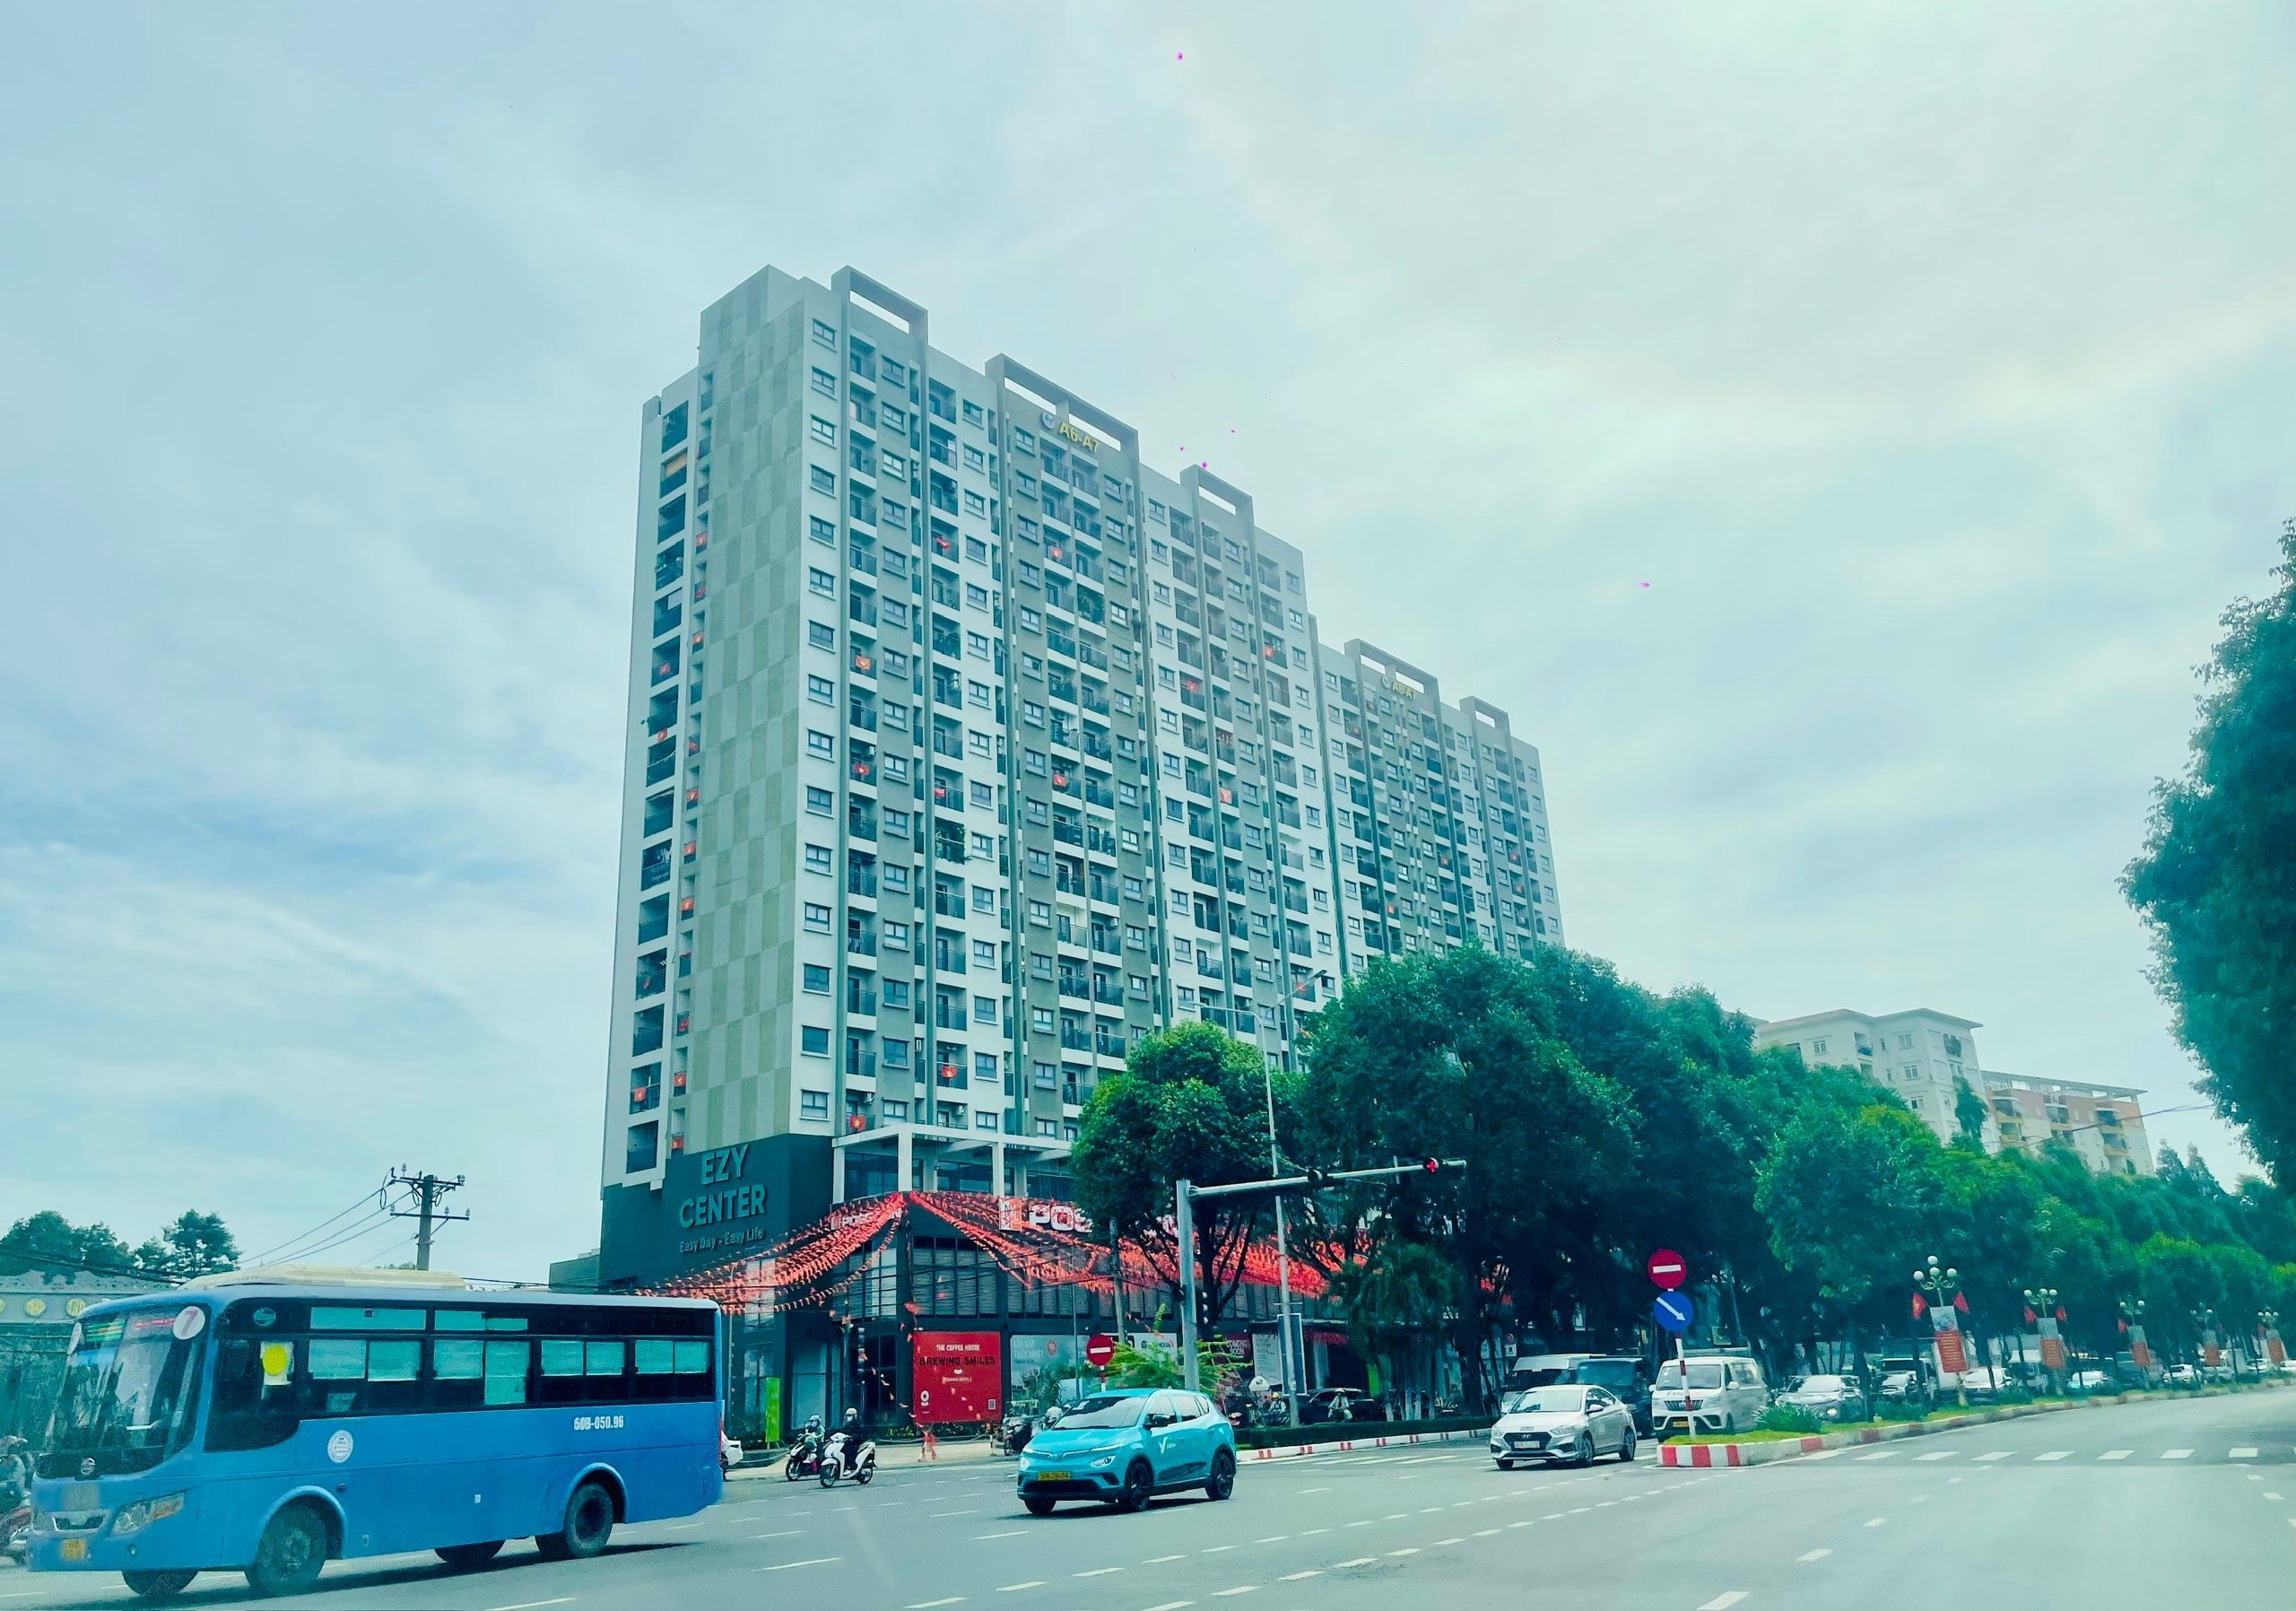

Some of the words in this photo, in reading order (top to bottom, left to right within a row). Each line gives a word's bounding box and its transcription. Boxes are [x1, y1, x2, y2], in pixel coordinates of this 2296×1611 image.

[1059, 421, 1100, 453] A6-A7
[701, 1144, 749, 1184] EZY
[679, 1184, 766, 1229] CENTER
[680, 1241, 699, 1253] Easy
[724, 1232, 744, 1245] Easy
[746, 1226, 764, 1241] Life
[181, 1310, 198, 1336] 7
[919, 1356, 961, 1366] BREWING
[964, 1355, 996, 1364] SMILES
